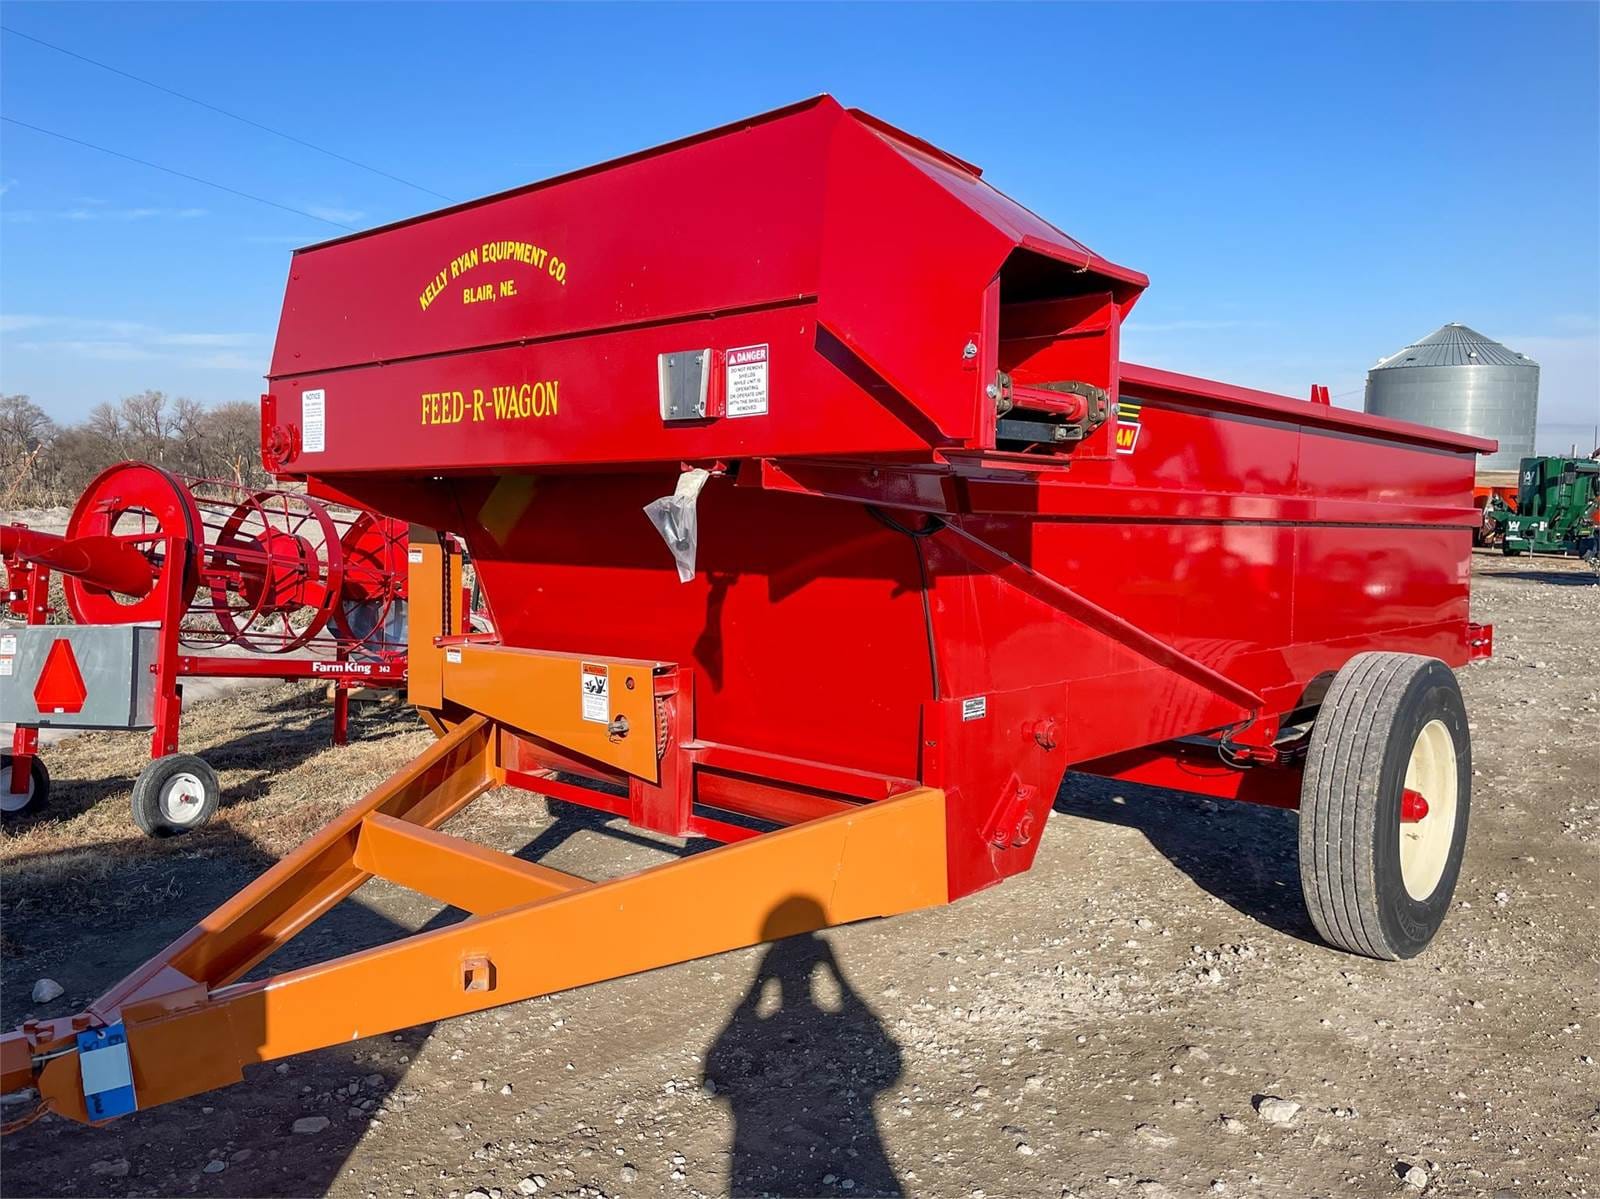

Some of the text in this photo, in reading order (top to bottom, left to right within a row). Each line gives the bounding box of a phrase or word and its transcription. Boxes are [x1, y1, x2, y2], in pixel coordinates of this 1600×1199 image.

[419, 240, 567, 311] KELLY RYAN EQUIPMENT CO.
[463, 279, 518, 304] BLAIR, NE.
[736, 349, 765, 362] DANGER
[306, 393, 321, 401] NOTICE
[421, 380, 559, 425] FEED-R-WAGON
[312, 662, 343, 672] Farm
[344, 662, 372, 675] King
